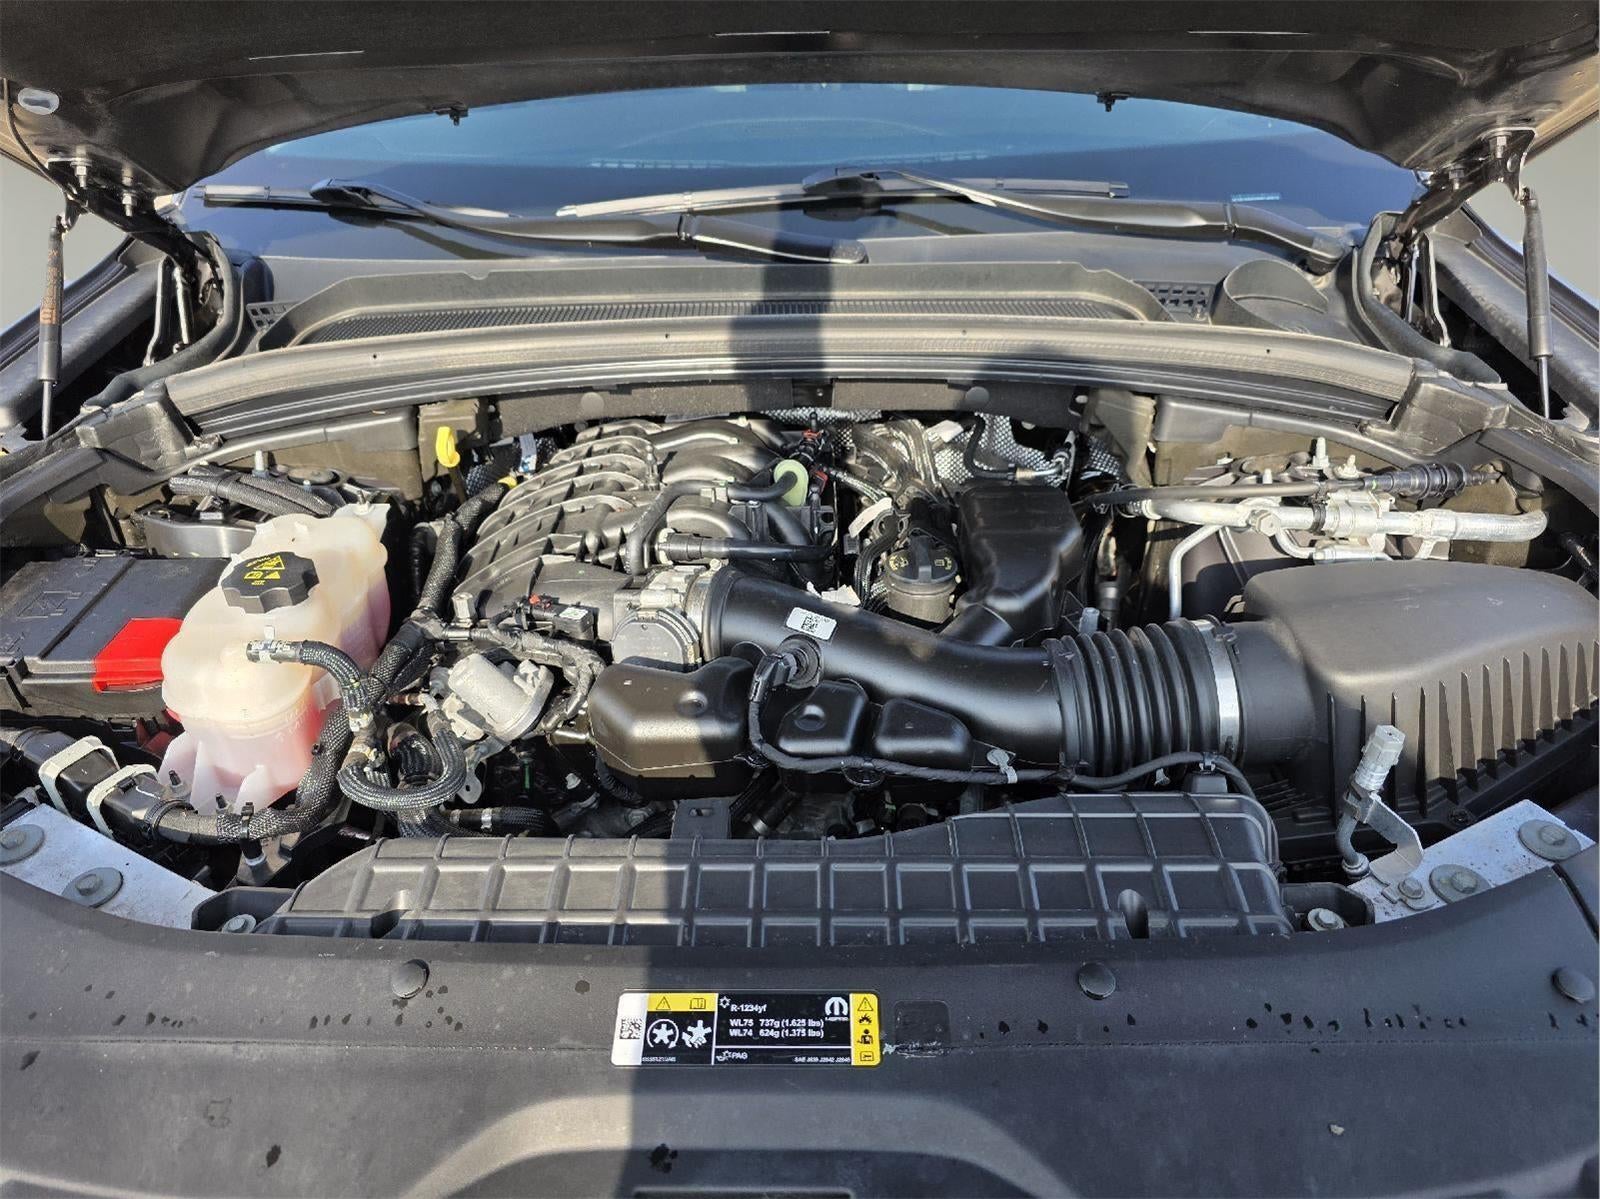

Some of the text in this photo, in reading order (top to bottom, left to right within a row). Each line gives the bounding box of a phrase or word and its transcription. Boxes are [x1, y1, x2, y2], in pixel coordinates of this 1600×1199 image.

[730, 1004, 767, 1014] R-1234yf
[729, 1019, 754, 1027] WL75
[759, 1019, 780, 1028] 737g
[781, 1018, 806, 1028] (1.625
[808, 1018, 824, 1028] lbs)
[729, 1028, 824, 1038] WL74 624g (1.375 lbs)
[731, 1052, 748, 1060] PAG
